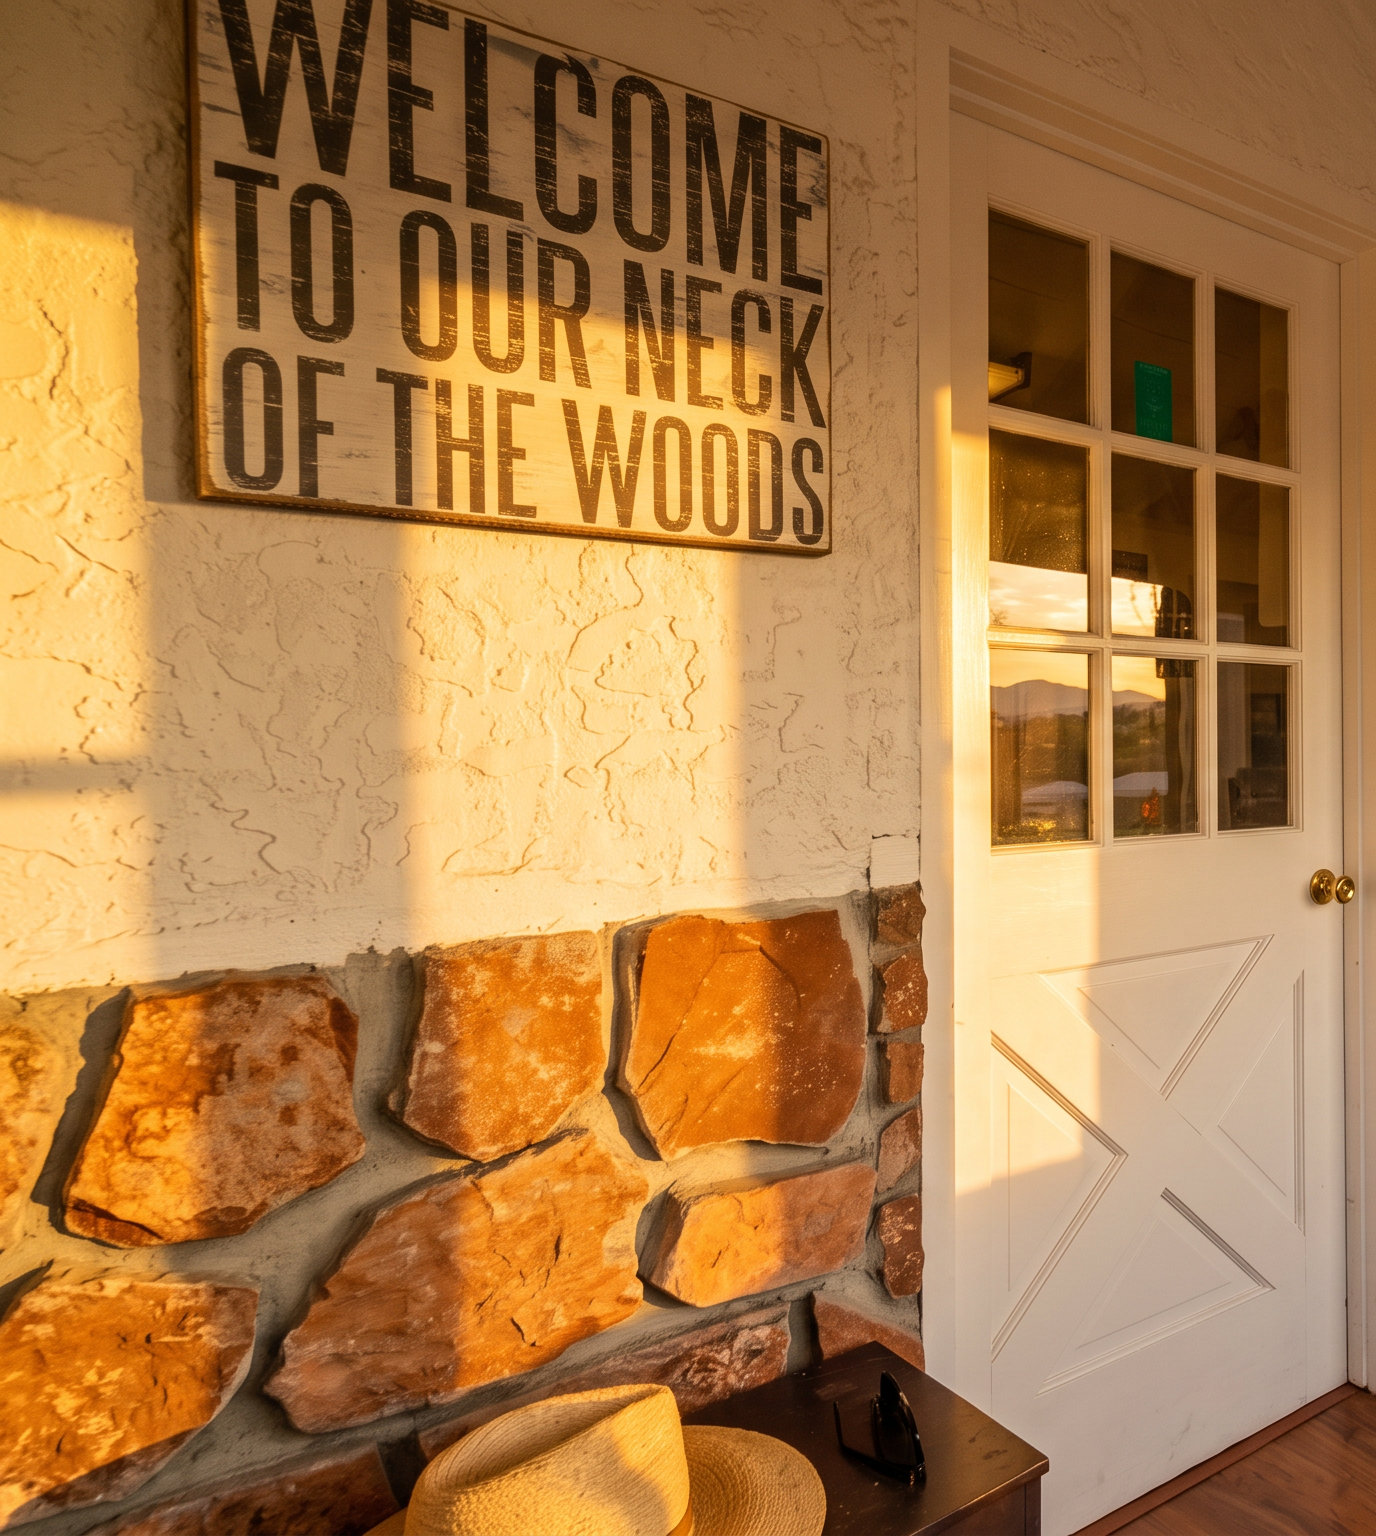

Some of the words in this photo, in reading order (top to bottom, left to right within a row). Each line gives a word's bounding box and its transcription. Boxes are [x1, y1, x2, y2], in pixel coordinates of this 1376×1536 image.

[221, 0, 823, 295] WELCOME
[214, 160, 355, 344] TO
[400, 209, 592, 389] OUR
[624, 258, 827, 429] NECK
[222, 347, 345, 498] OF
[376, 367, 537, 518] THE
[561, 398, 825, 546] WOODS
